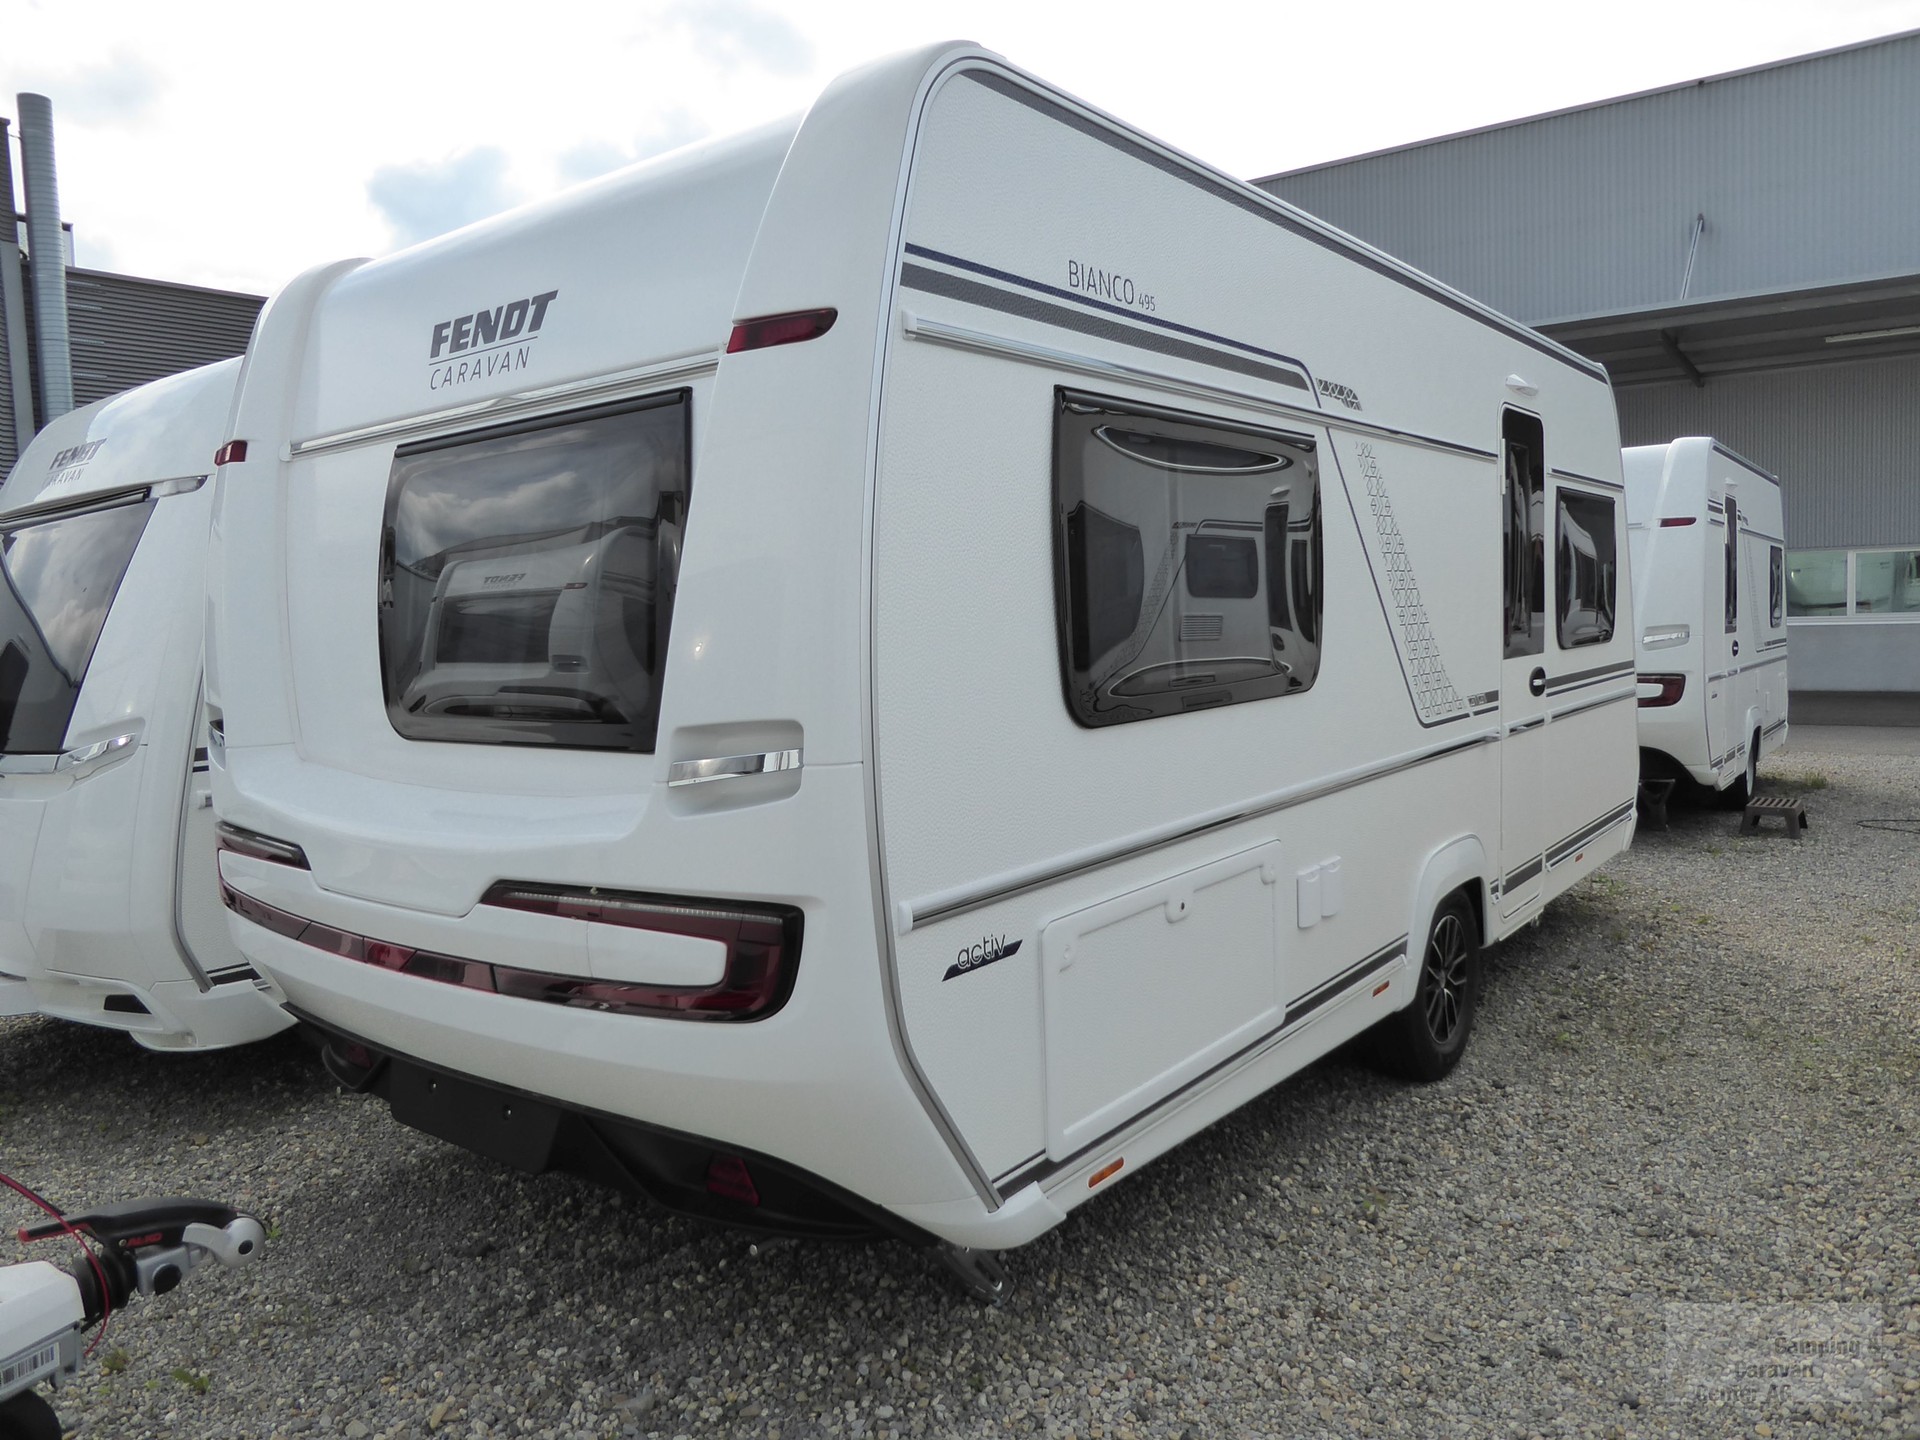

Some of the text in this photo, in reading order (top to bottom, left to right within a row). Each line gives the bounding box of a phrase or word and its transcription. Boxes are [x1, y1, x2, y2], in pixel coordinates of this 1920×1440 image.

[1068, 259, 1155, 311] BIANCO 495
[429, 289, 558, 359] FENDT
[430, 346, 530, 390] CARAVAN
[49, 437, 107, 470] FENDT
[957, 933, 1006, 969] activ
